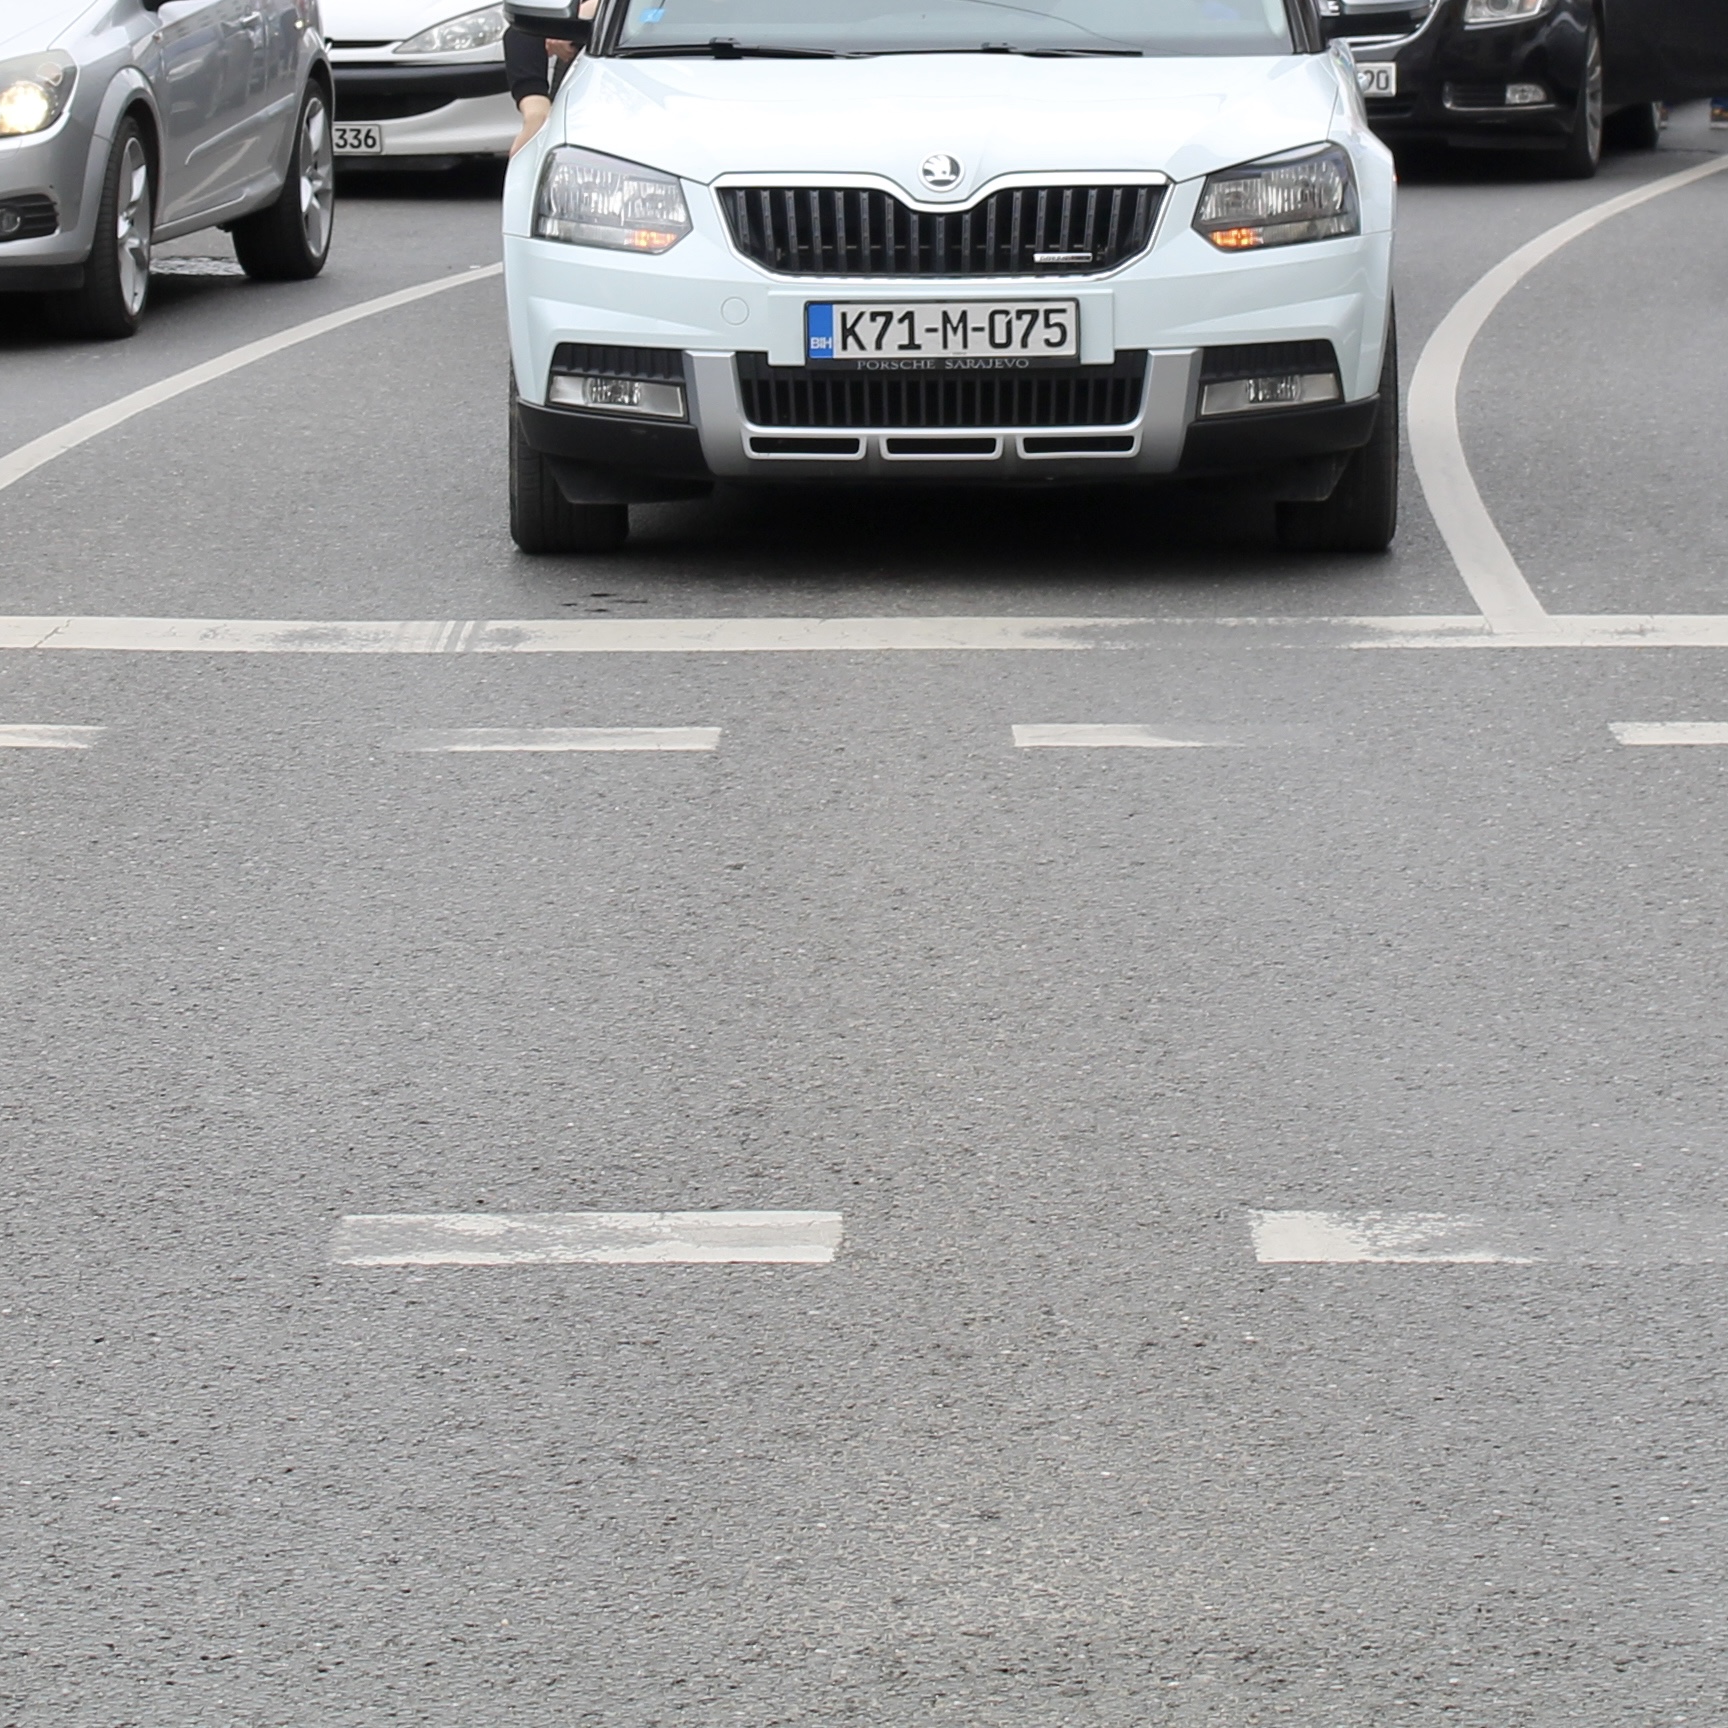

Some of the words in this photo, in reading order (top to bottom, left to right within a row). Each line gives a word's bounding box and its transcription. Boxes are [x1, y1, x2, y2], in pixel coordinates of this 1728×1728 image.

[810, 337, 832, 350] BIH
[840, 308, 1068, 351] K71-M-075
[857, 359, 935, 370] PORSCHE
[945, 358, 1029, 369] SARAJEVO
